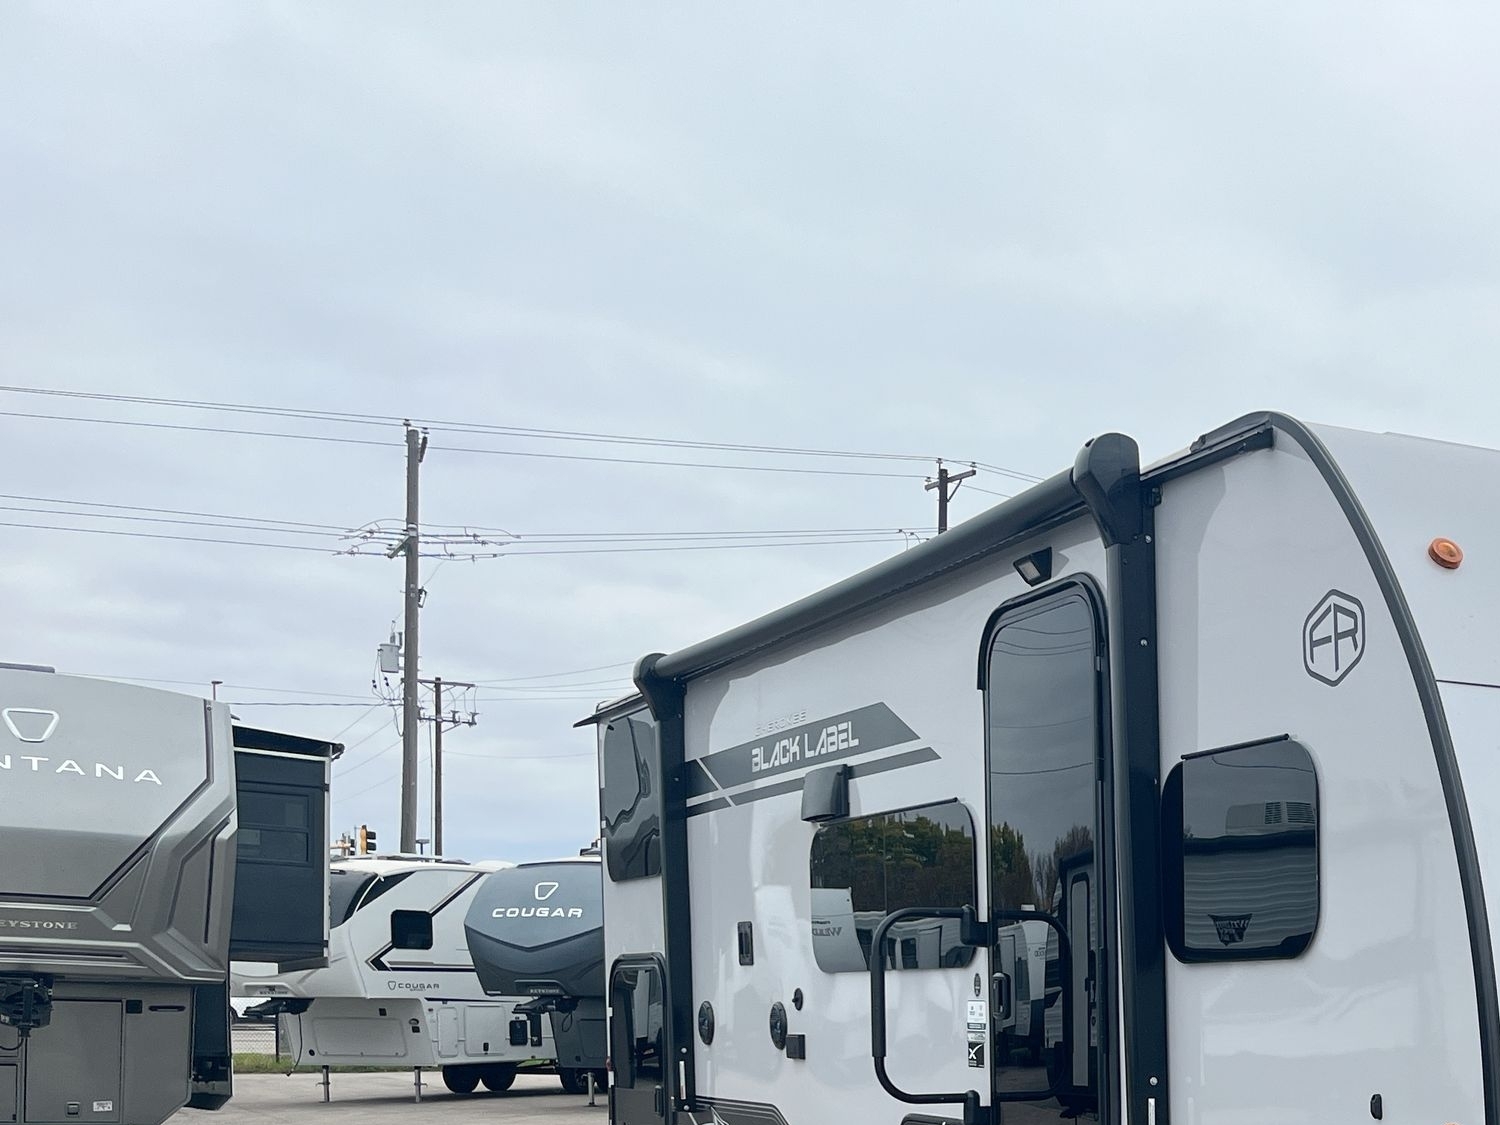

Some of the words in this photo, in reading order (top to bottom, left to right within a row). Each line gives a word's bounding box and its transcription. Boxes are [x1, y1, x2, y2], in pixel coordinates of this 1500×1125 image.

[751, 735, 800, 773] BLACK
[804, 720, 860, 758] LABEL
[491, 907, 584, 918] COUGAR
